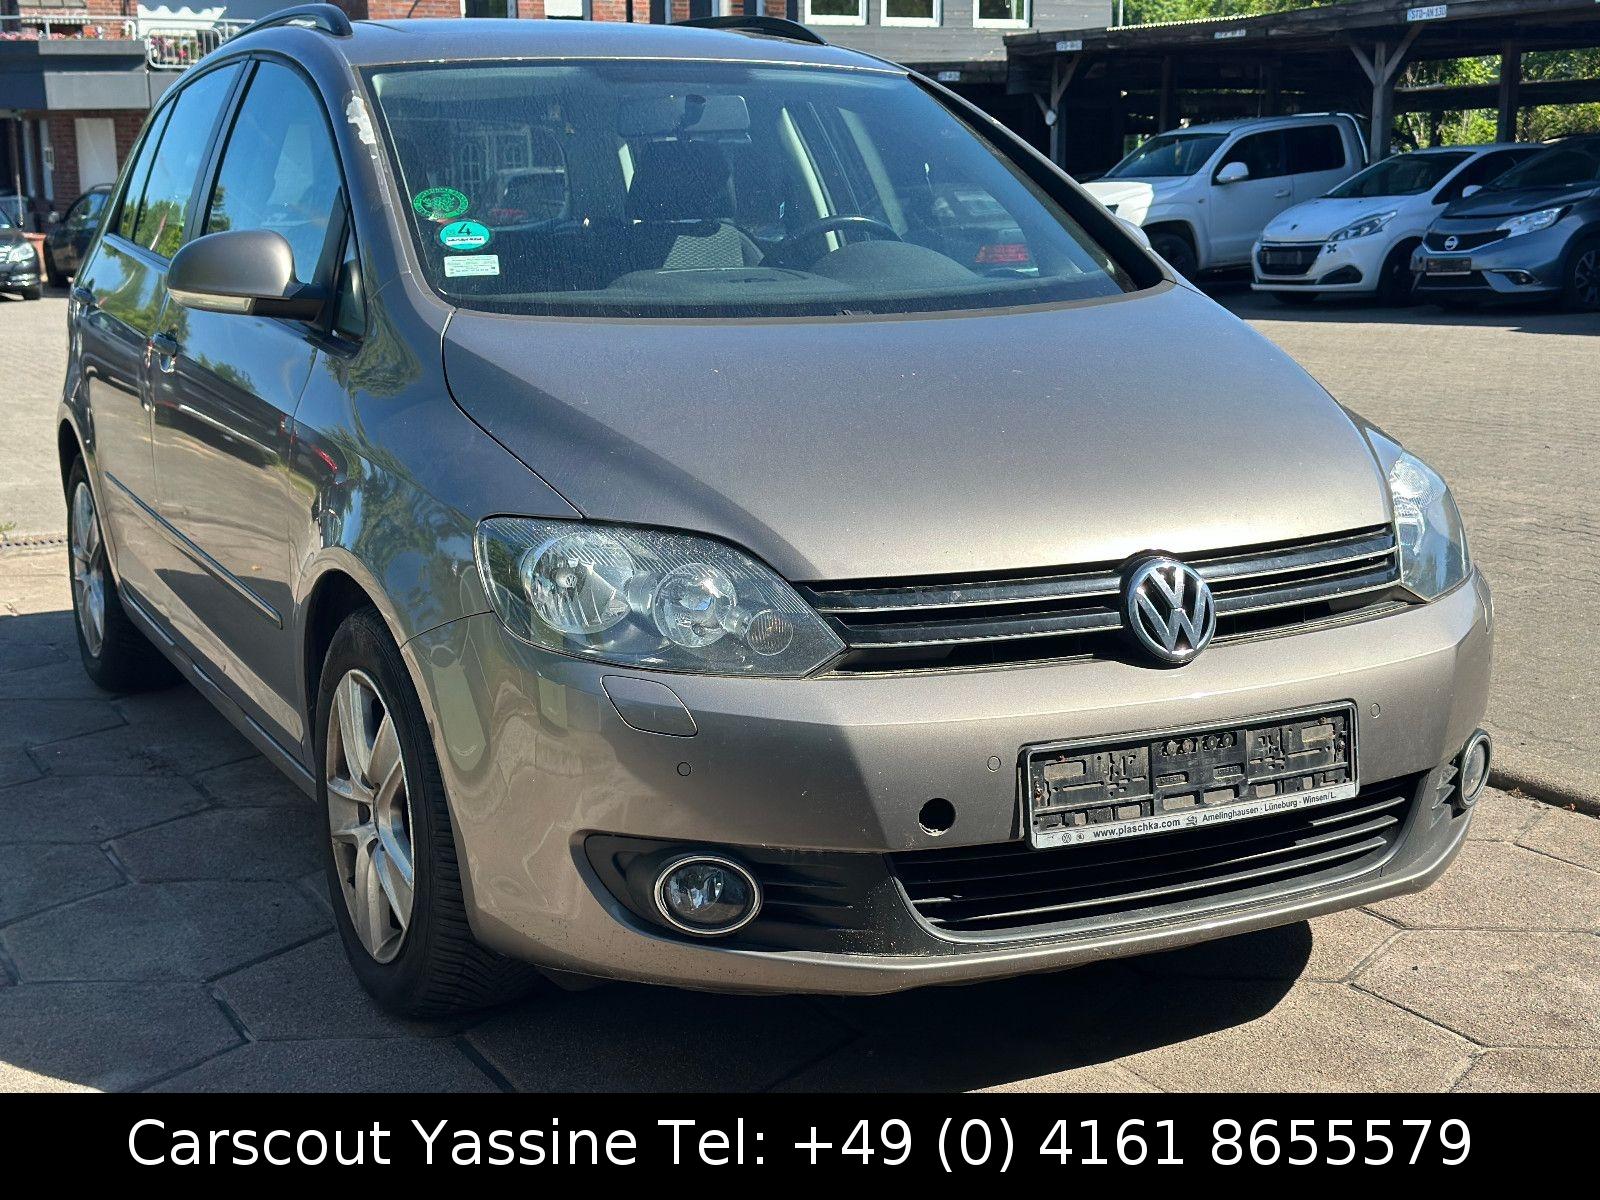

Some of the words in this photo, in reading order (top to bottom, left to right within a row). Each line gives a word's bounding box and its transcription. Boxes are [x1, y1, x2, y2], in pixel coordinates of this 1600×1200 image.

[457, 223, 472, 236] 4
[1093, 817, 1181, 839] www.plaschka.com
[1202, 806, 1259, 822] Amelinghausen
[1264, 799, 1298, 812] Lüneburg
